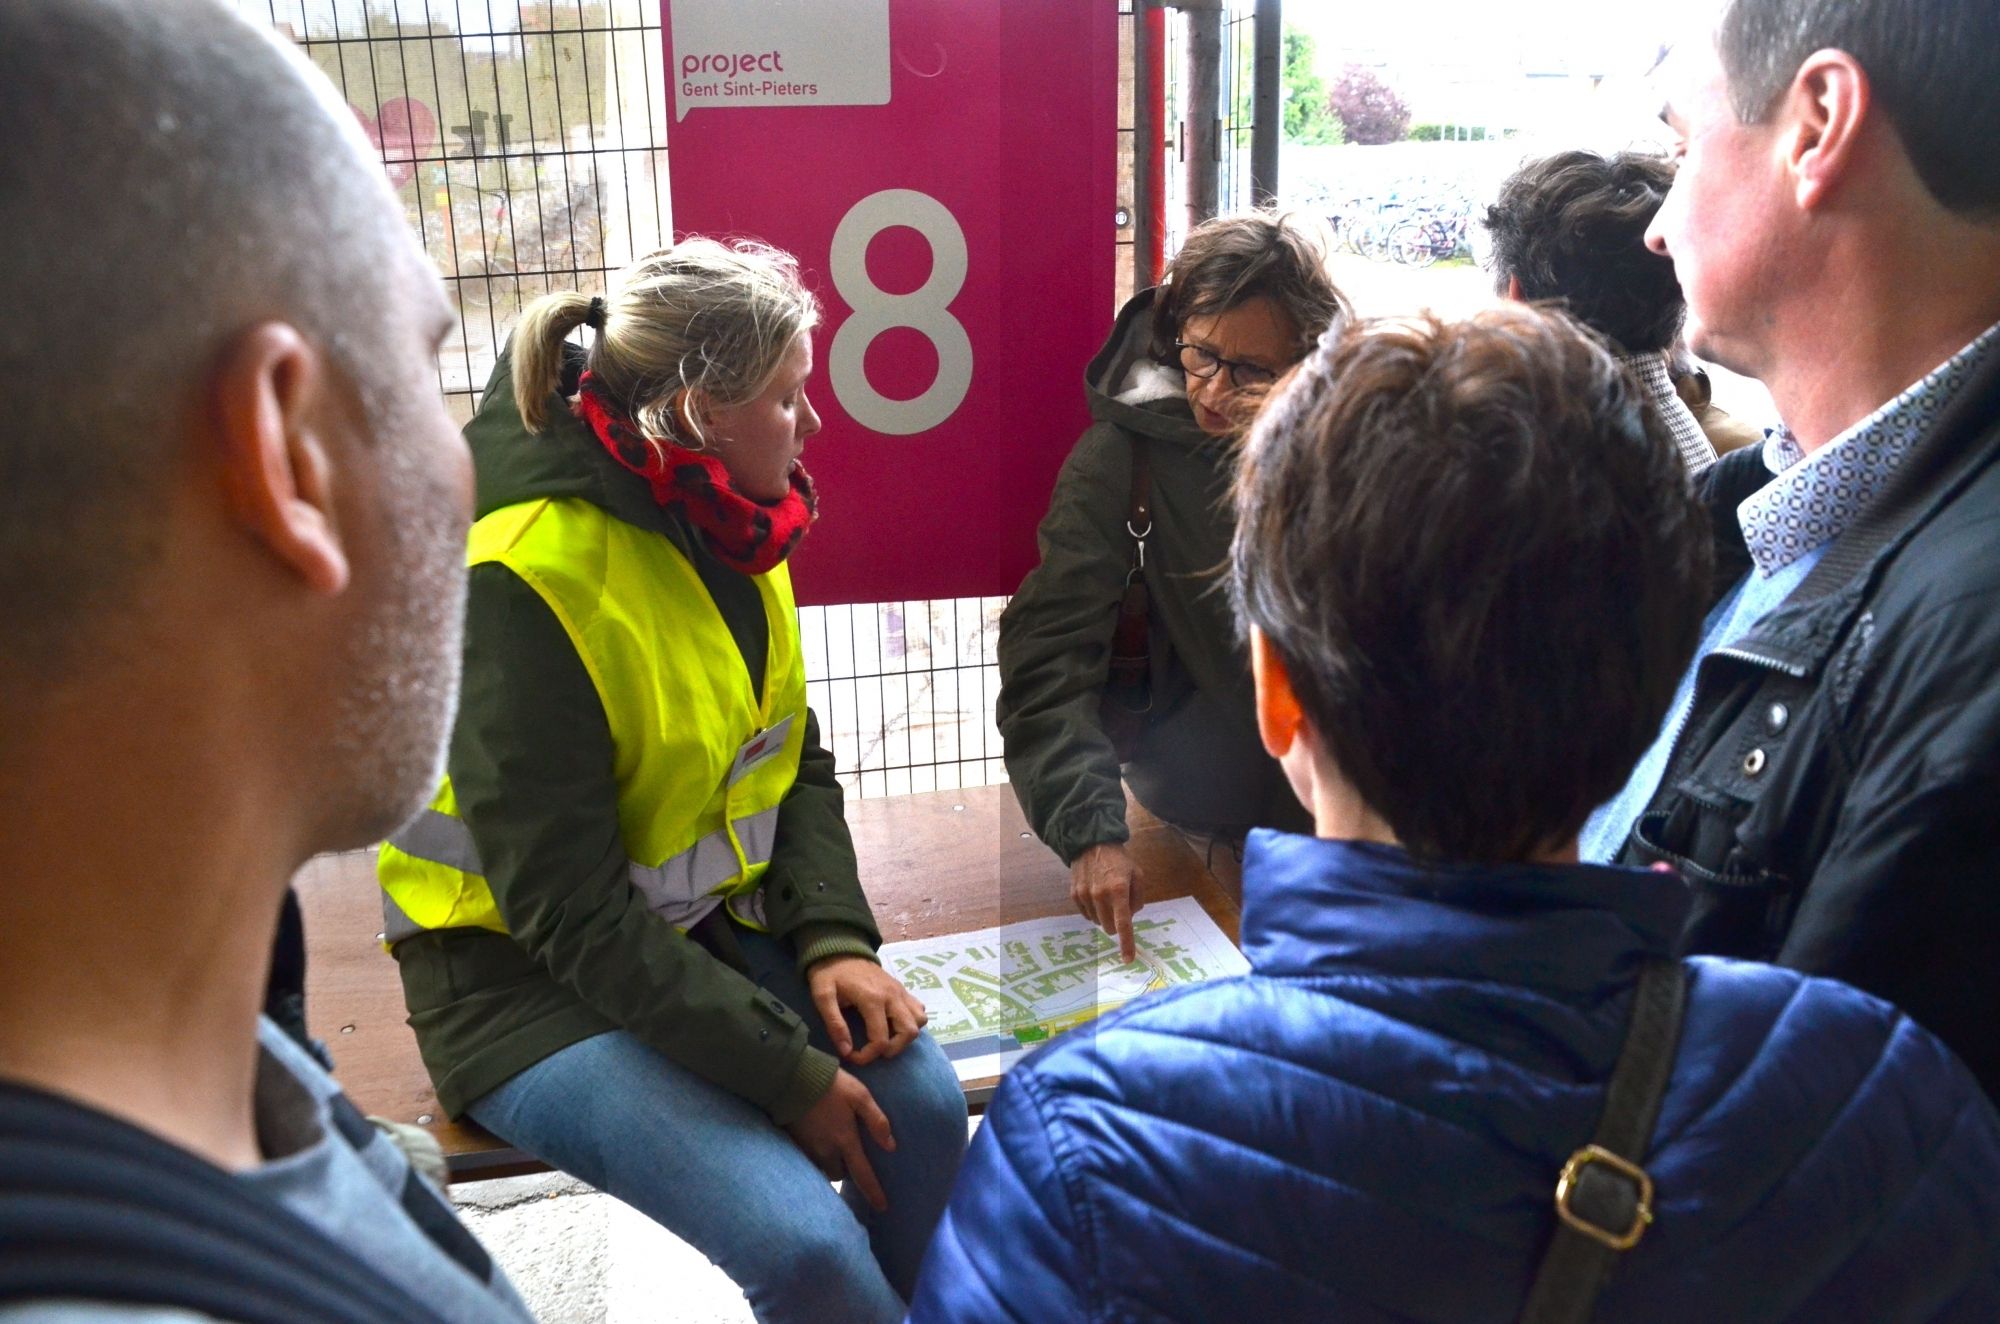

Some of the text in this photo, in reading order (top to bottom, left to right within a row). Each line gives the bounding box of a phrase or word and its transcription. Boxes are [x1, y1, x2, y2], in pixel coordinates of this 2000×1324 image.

[682, 51, 784, 79] project
[682, 81, 818, 96] Gent Sint-Pieters
[829, 188, 973, 435] 8
